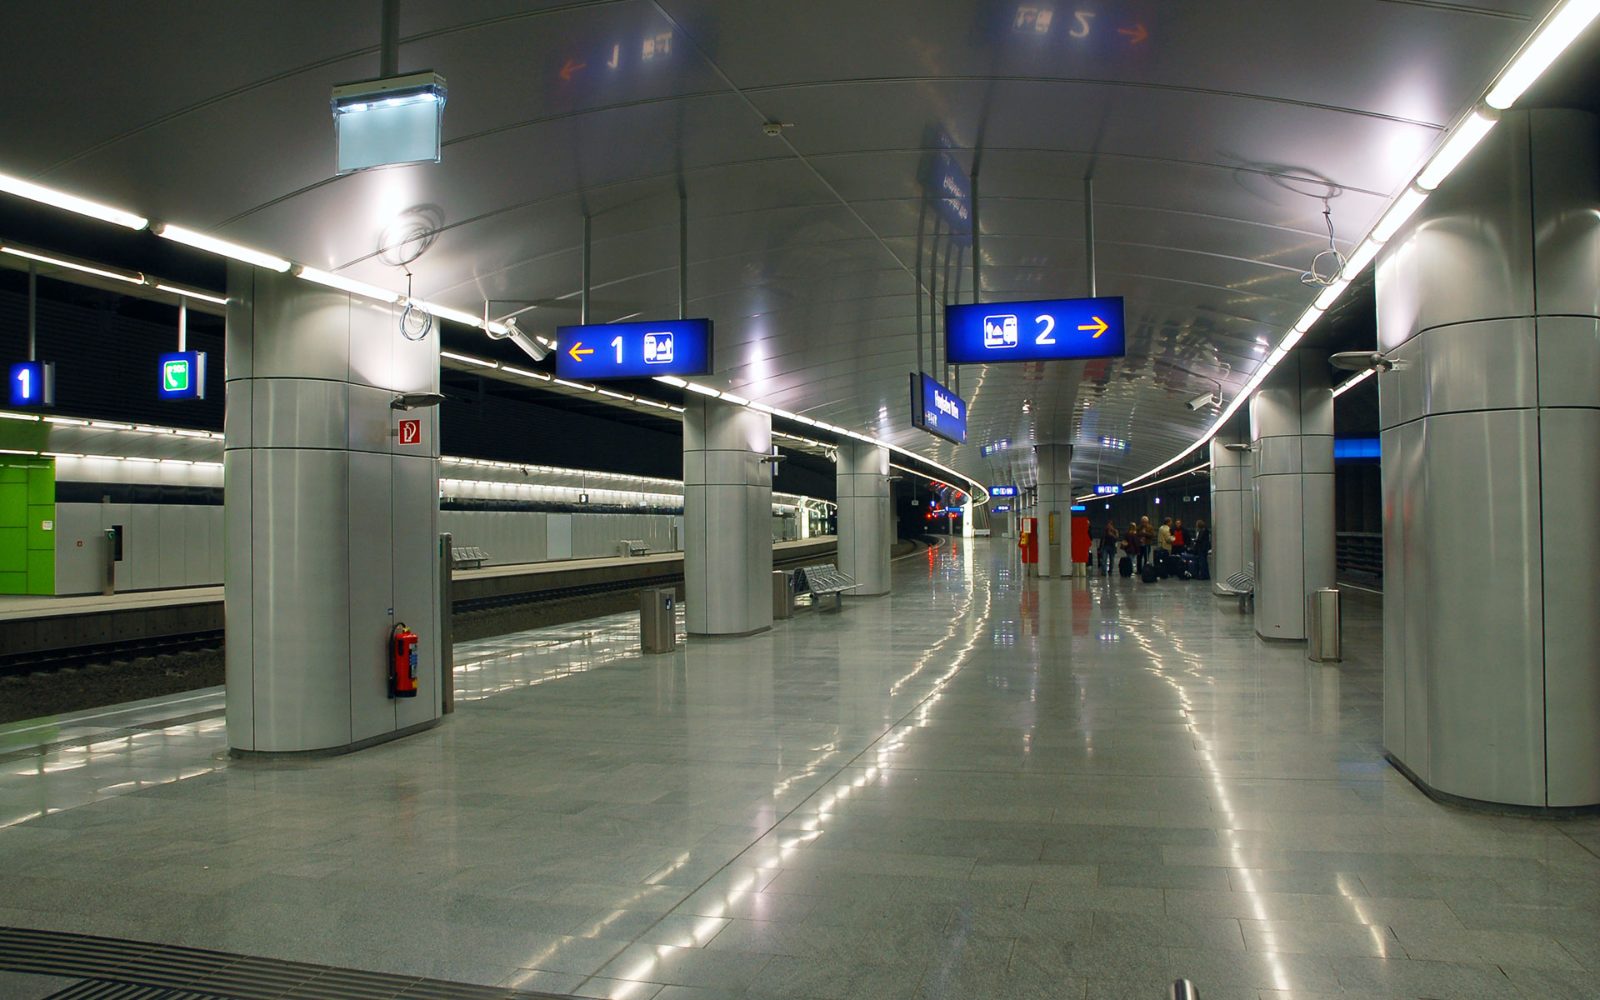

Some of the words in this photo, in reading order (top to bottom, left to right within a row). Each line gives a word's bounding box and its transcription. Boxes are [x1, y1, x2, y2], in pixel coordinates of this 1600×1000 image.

[1035, 314, 1056, 345] 2
[611, 335, 623, 364] 1
[17, 368, 30, 399] 1
